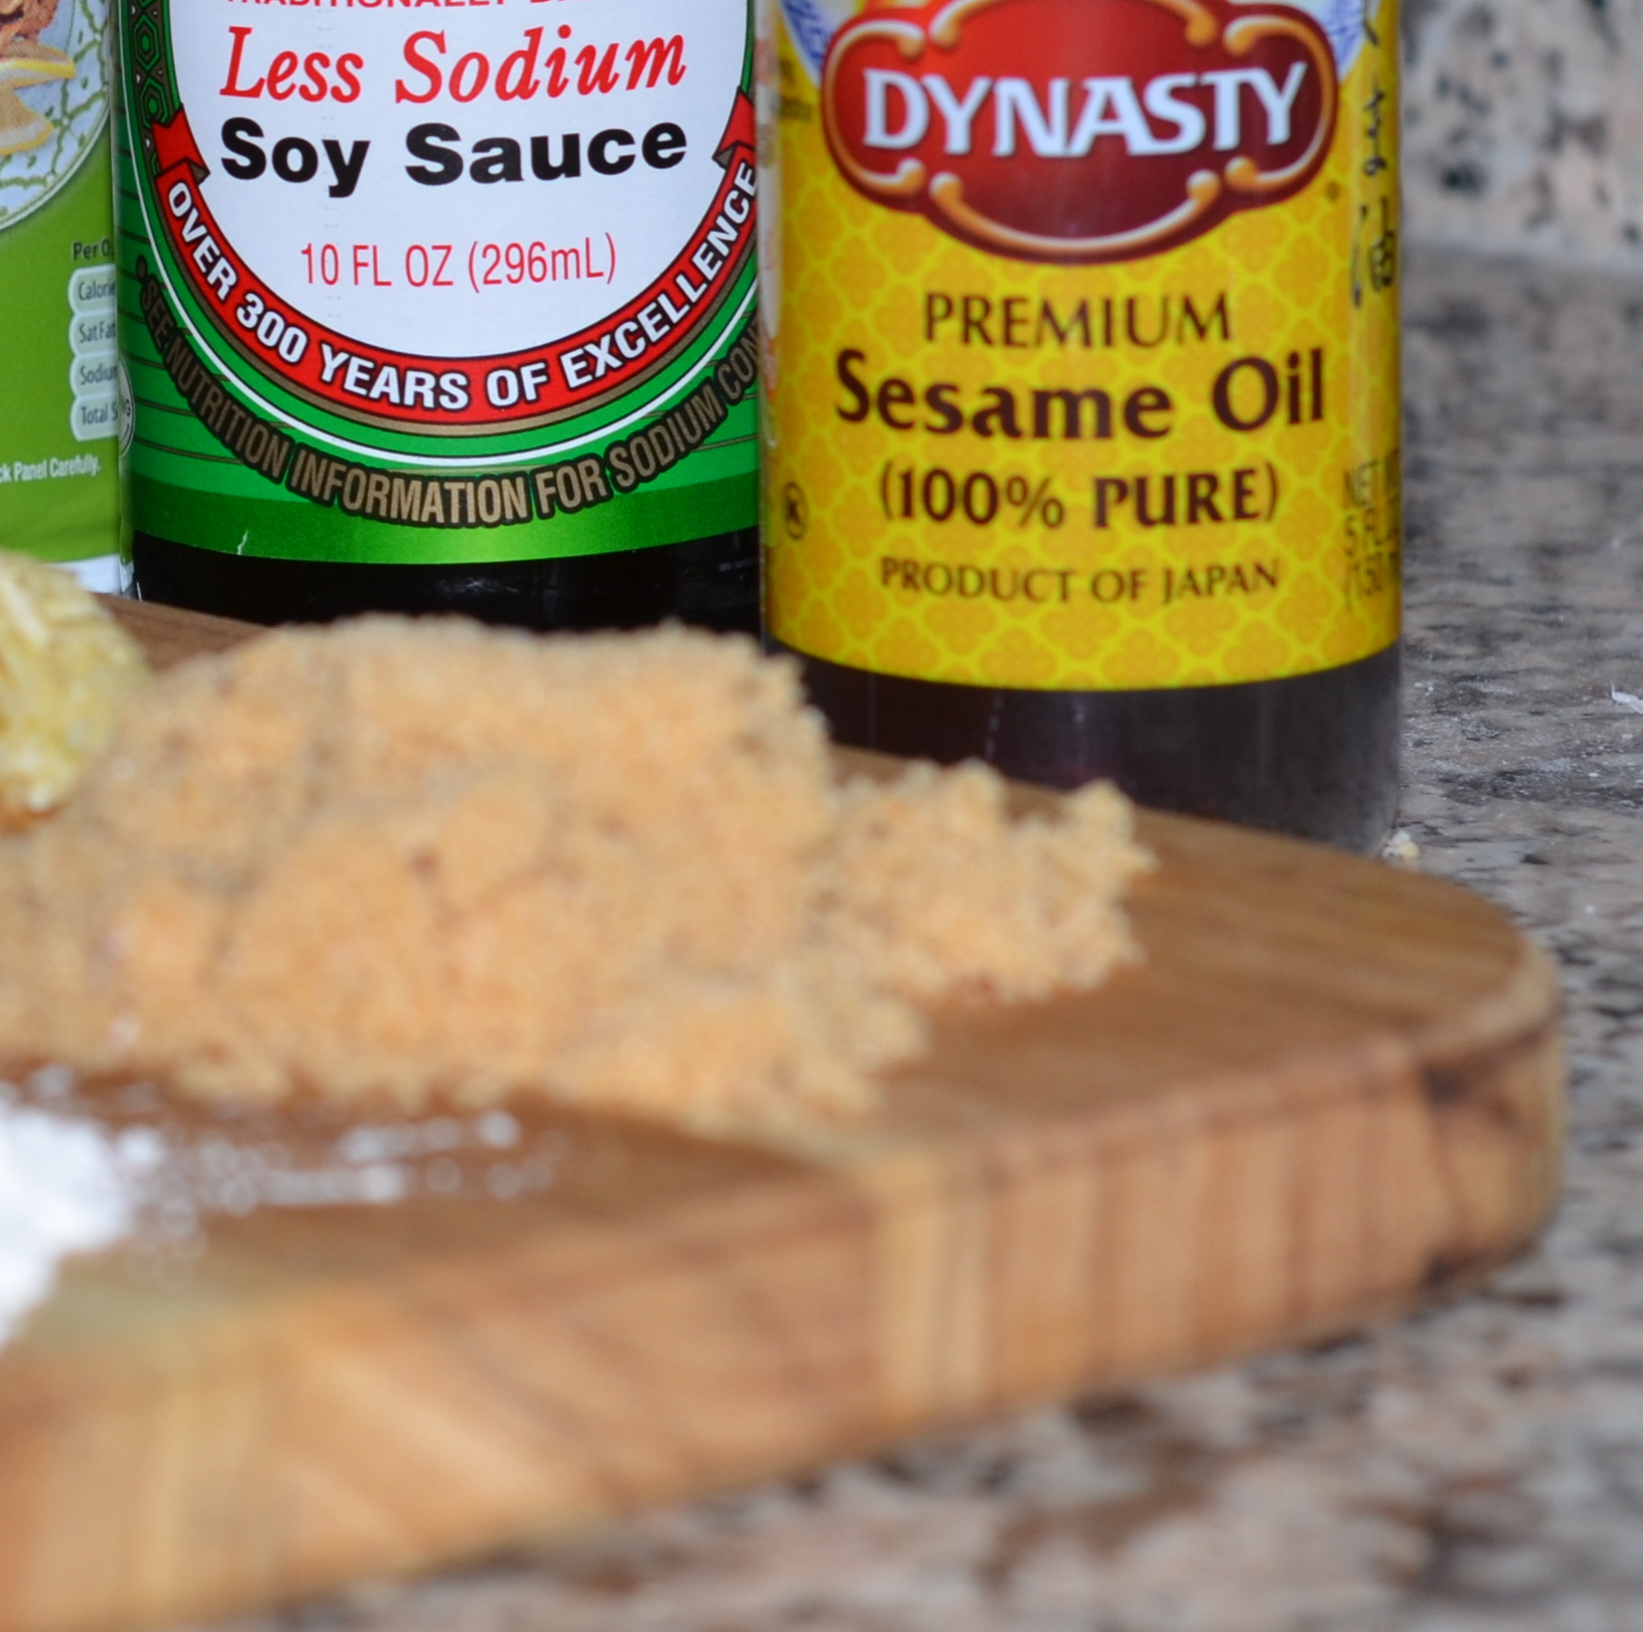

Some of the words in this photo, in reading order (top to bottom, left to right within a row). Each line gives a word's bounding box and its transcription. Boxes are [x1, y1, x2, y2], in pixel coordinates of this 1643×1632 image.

[218, 24, 366, 105] Less
[394, 23, 689, 105] Sodium
[861, 62, 1308, 158] DYNASTY
[219, 115, 372, 199] Soy
[403, 120, 689, 187] Sauce
[72, 241, 99, 262] Per
[167, 180, 239, 302] OVER
[235, 295, 308, 366] 300
[319, 343, 471, 411] YEARS
[485, 368, 549, 409] OF
[563, 161, 756, 390] EXCELLENCE
[299, 241, 341, 287] 10
[352, 244, 393, 287] FL
[405, 243, 455, 288] OZ
[467, 232, 618, 295] (296mL)
[923, 291, 1232, 348] PREMIUM
[80, 403, 109, 427] Total
[834, 347, 1174, 439] Sesame
[1210, 348, 1325, 433] Oil
[162, 335, 294, 485] NUTRITION
[288, 442, 536, 528] INFORMATION
[531, 455, 614, 519] FOR
[608, 375, 729, 493] SODIUM
[13, 461, 48, 483] Panel
[49, 453, 102, 479] Carefully.
[879, 457, 1067, 529] (100%
[1091, 459, 1279, 529] PURE)
[879, 556, 1076, 604] PRODUCT
[1089, 567, 1147, 604] OF
[1162, 557, 1281, 605] JAPAN
